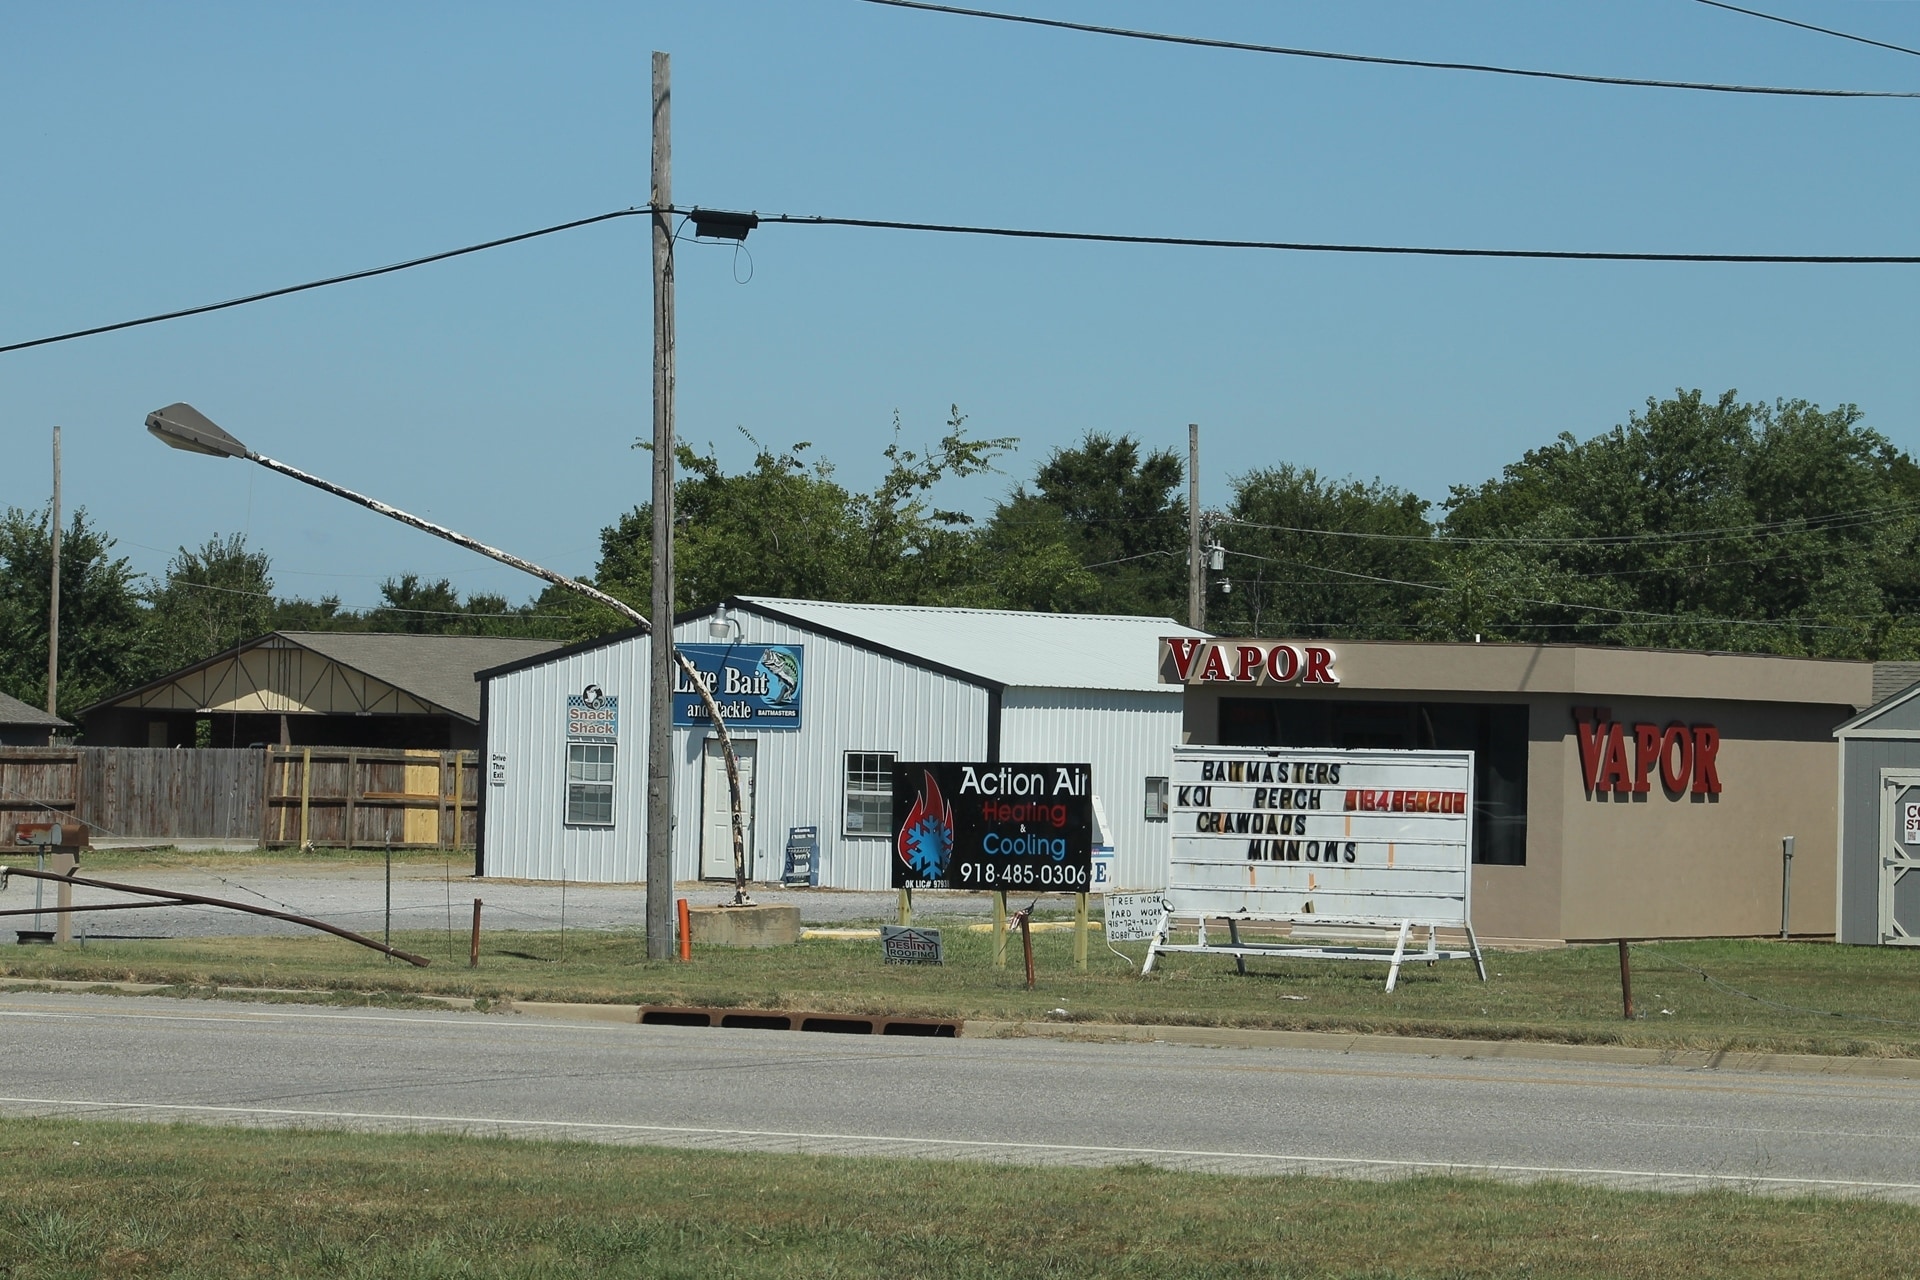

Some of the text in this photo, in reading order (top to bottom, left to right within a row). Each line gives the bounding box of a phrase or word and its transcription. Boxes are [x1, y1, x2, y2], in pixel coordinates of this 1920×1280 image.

[1167, 638, 1338, 683] VAPOR
[724, 666, 769, 694] Bait
[569, 708, 614, 720] Snack
[757, 709, 796, 717] BAITMASTERS
[569, 722, 614, 734] Shack
[1573, 706, 1722, 794] VAPOR
[960, 766, 1088, 796] Action Air
[1202, 761, 1340, 784] BAITMASTERS
[1178, 786, 1211, 807] KOI
[1254, 788, 1321, 809] PERCH
[983, 801, 1066, 827] Heating
[1020, 824, 1026, 832] &
[1197, 812, 1306, 835] CRAWDADS
[983, 833, 1066, 861] Cooling
[1248, 839, 1356, 863] MINNOWS
[905, 880, 914, 888] OK
[916, 880, 932, 888] LIC#
[1109, 895, 1161, 906] TREE WORK
[1111, 908, 1162, 919] YARD WORK
[1111, 930, 1130, 940] BOBBY
[888, 939, 935, 951] DESTINY
[890, 949, 935, 959] ROOFING
